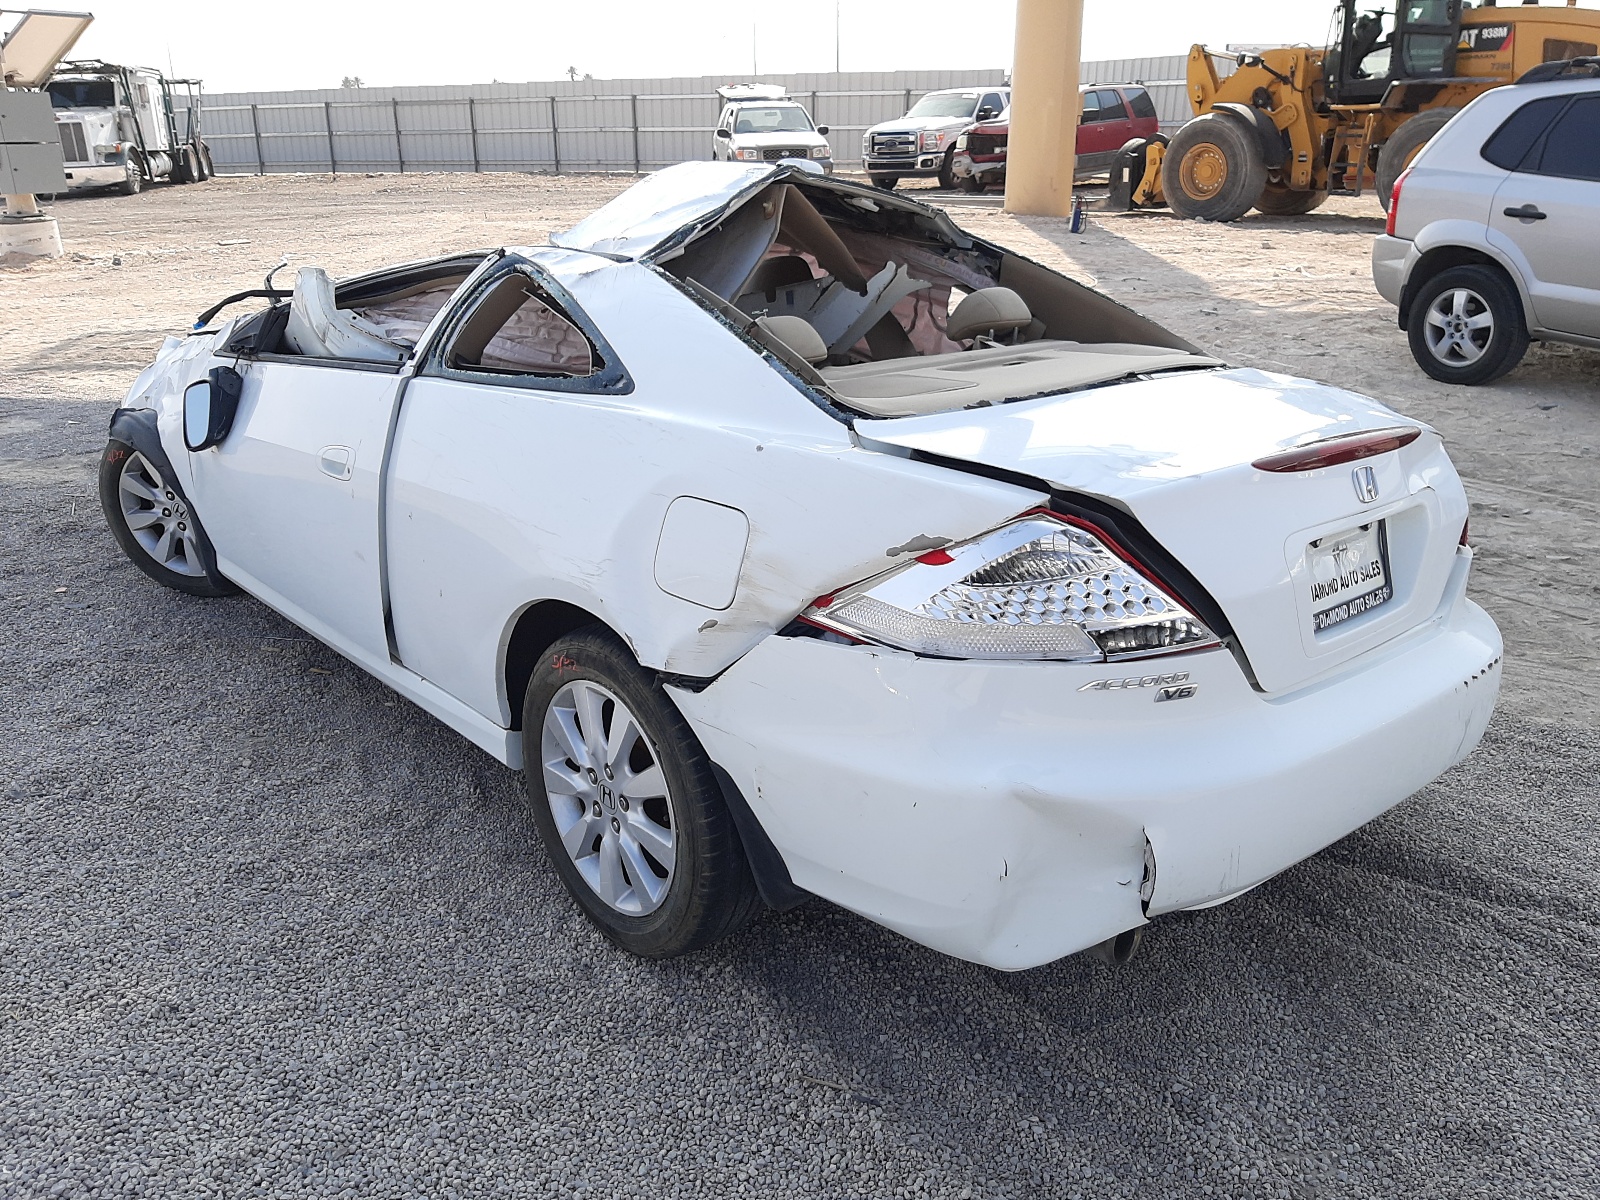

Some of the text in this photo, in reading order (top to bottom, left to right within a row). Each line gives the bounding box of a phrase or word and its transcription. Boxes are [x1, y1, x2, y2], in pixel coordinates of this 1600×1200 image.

[1457, 26, 1507, 48] AT 938M
[1310, 560, 1381, 602] IAMOND AUTO SALES
[1319, 590, 1384, 628] DIAMOND AUTO SALES
[1077, 671, 1190, 692] ACCORD
[1164, 687, 1193, 700] V6
